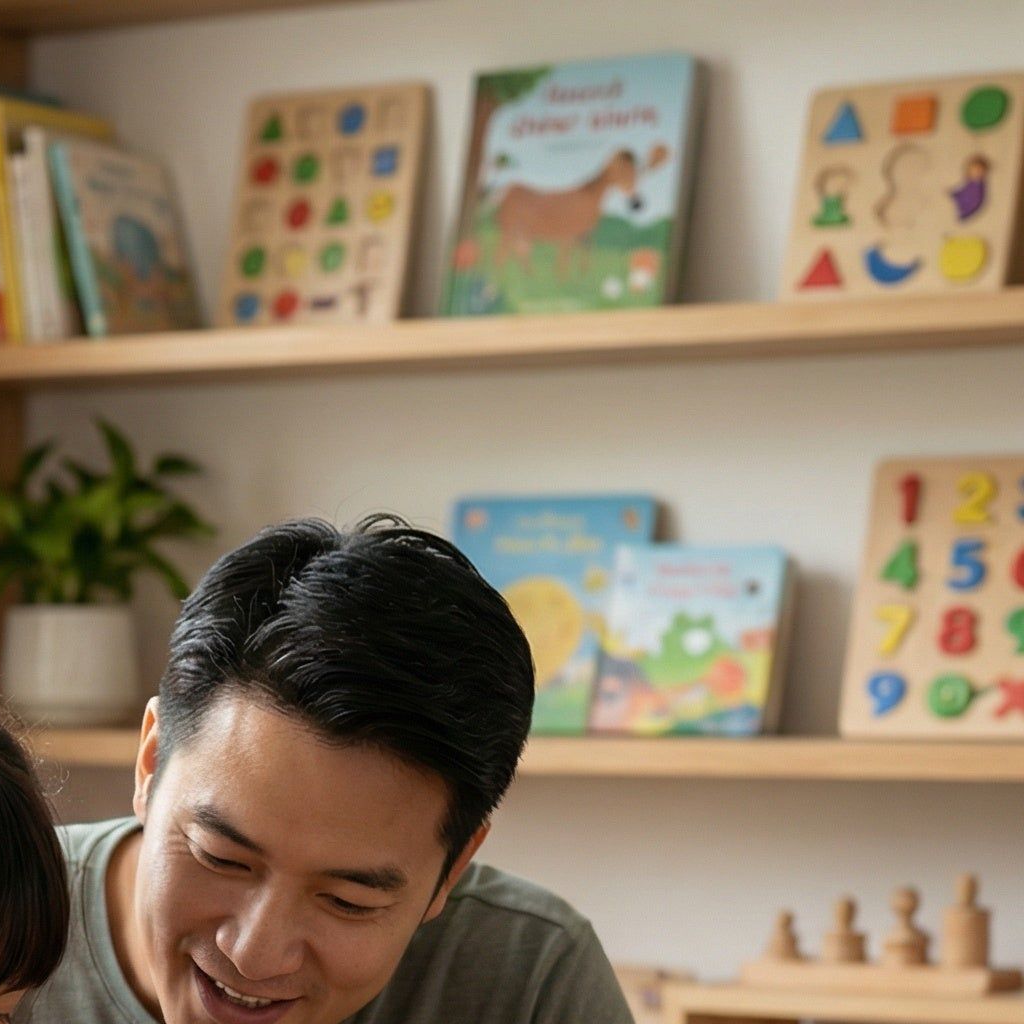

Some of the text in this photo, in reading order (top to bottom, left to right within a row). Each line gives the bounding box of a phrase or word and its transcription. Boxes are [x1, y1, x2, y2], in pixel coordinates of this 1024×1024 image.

[952, 471, 997, 525] 2
[947, 538, 987, 591] 5
[875, 605, 915, 656] 7
[938, 606, 978, 655] 8
